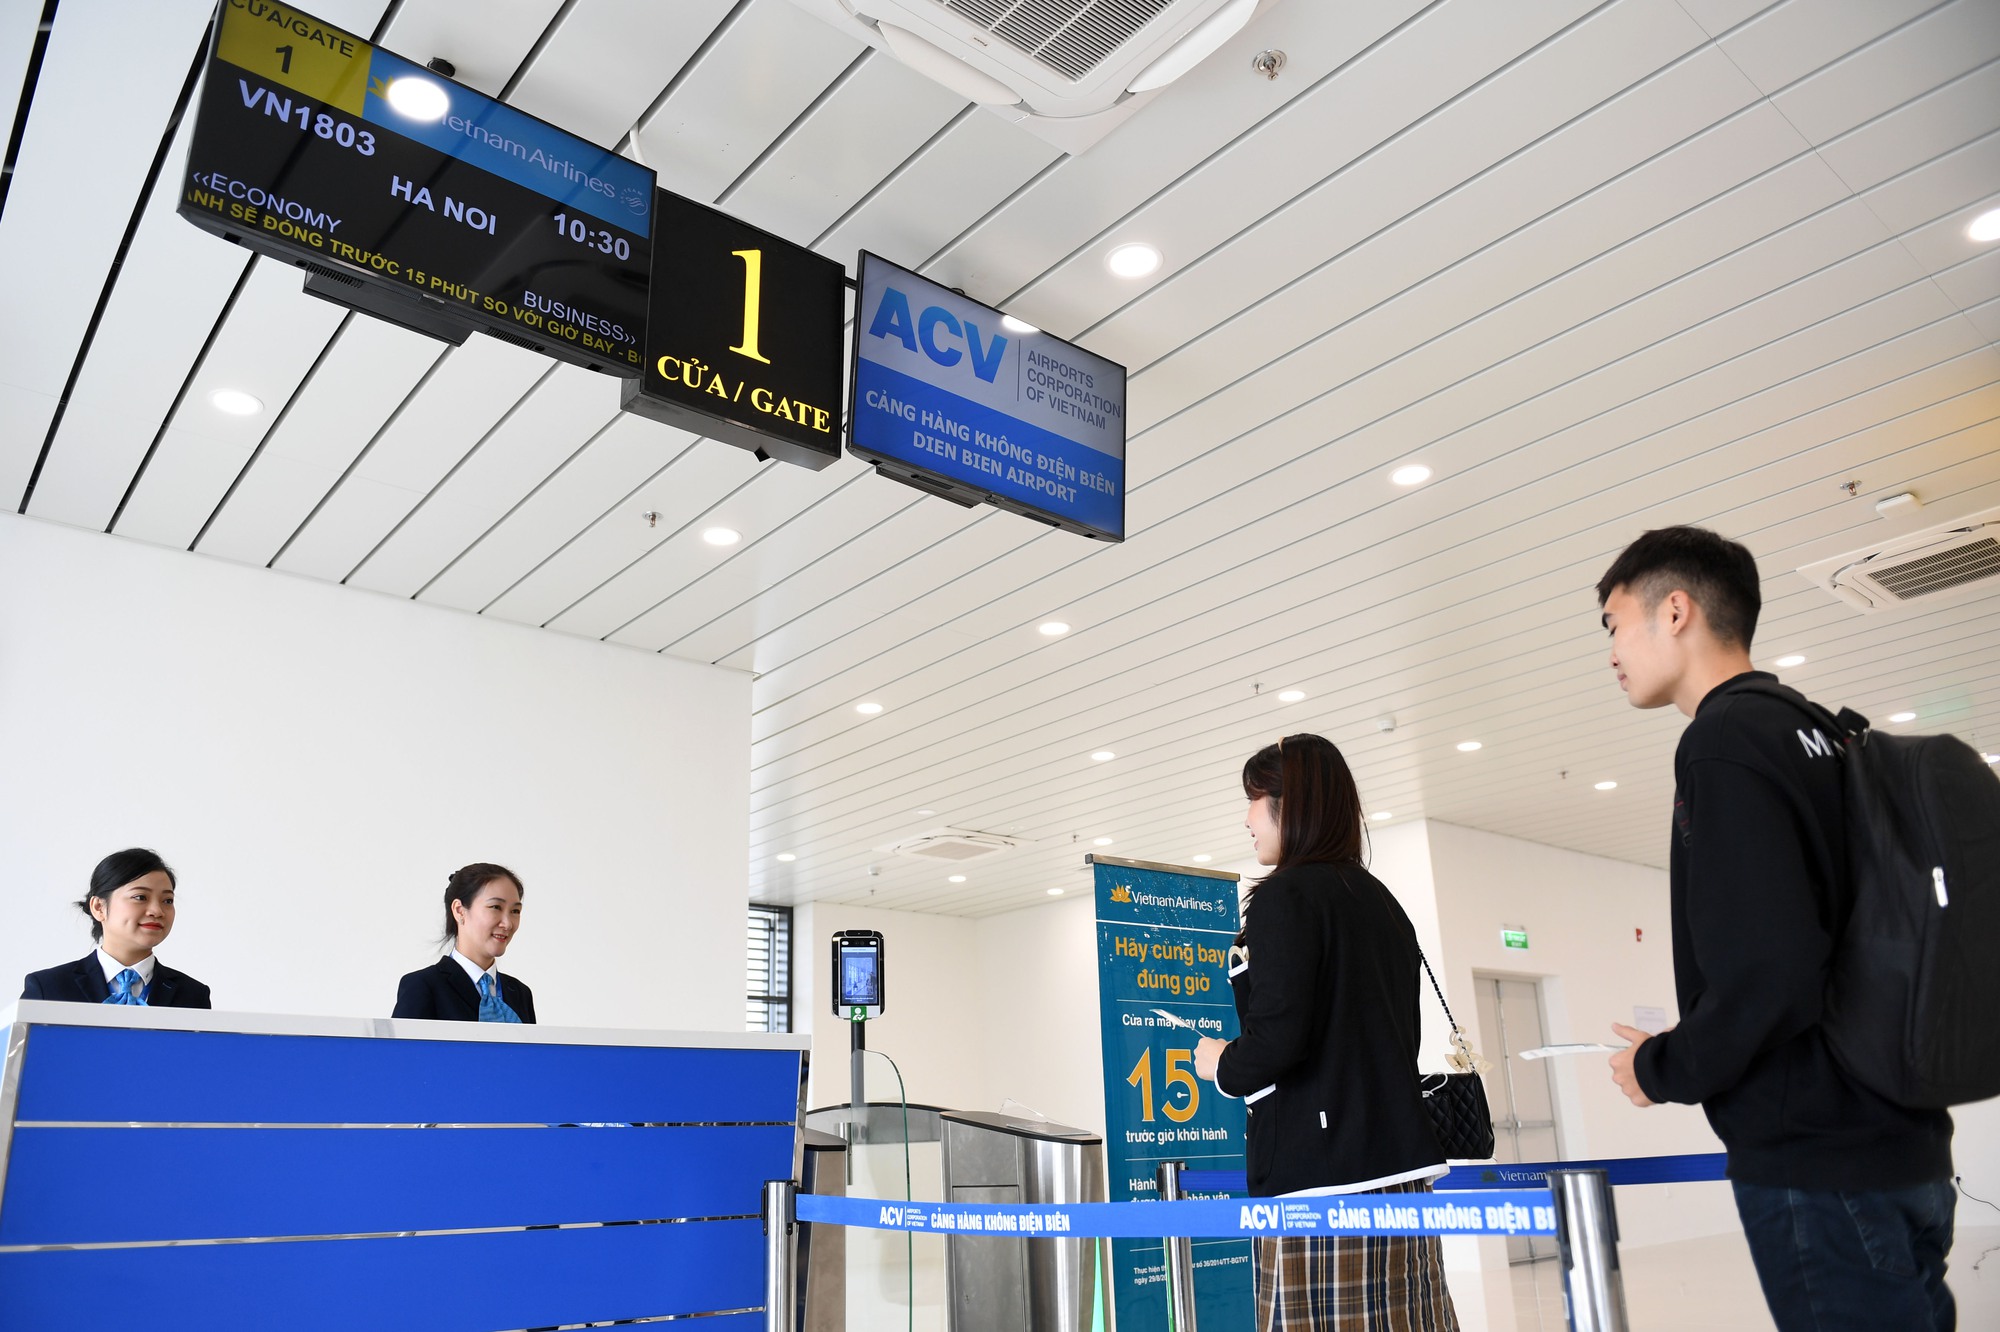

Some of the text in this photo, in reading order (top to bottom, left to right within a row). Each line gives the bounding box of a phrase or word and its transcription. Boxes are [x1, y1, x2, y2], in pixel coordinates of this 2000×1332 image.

[275, 45, 294, 74] 1
[239, 79, 377, 156] VN1803
[528, 148, 616, 198] Airlines
[391, 175, 497, 236] HA NOI
[553, 213, 630, 261] 10:30
[230, 203, 258, 224] SẼ
[263, 214, 323, 248] ĐÓNG
[330, 238, 400, 275] TRƯỚC
[406, 268, 426, 285] 15
[430, 276, 480, 304] PHÚT
[483, 296, 508, 315] SO
[513, 306, 543, 328] VỚI
[548, 321, 580, 341] GIỜ
[582, 333, 615, 354] BAY
[729, 249, 771, 365] 1
[868, 286, 1008, 385] ACV
[1027, 350, 1094, 389] AIRPORTS
[657, 355, 728, 399] CỬA
[751, 387, 831, 433] GATE
[1026, 386, 1106, 430] OF VIETNAM
[1027, 369, 1121, 418] CORPORATION
[865, 389, 1115, 497] CẢNG HÀNG KHÔNG ĐIỆN BIÊN
[913, 431, 1077, 503] DIEN BIEN AIRPORT
[1131, 890, 1175, 907] Vietnam
[1176, 896, 1213, 912] Airlines
[1115, 936, 1226, 968] Hãy cùng bay
[1137, 968, 1210, 996] đúng giờ
[1144, 1017, 1155, 1027] ra
[1198, 1017, 1222, 1031] đóng
[1126, 1046, 1199, 1123] 15
[1126, 1127, 1228, 1145] trước giờ khởi hành
[1129, 1178, 1157, 1191] Hành
[1499, 1170, 1547, 1182] Vietnam
[879, 1206, 903, 1226] ACV
[931, 1207, 1070, 1234] CẢNG HÀNG KHÔNG ĐIỆN BIÊN
[1240, 1204, 1279, 1230] ACV
[1327, 1200, 1371, 1229] CẢNG
[1373, 1203, 1419, 1229] HÀNG
[1422, 1202, 1483, 1230] KHÔNG
[1485, 1202, 1531, 1234] ĐIỆN
